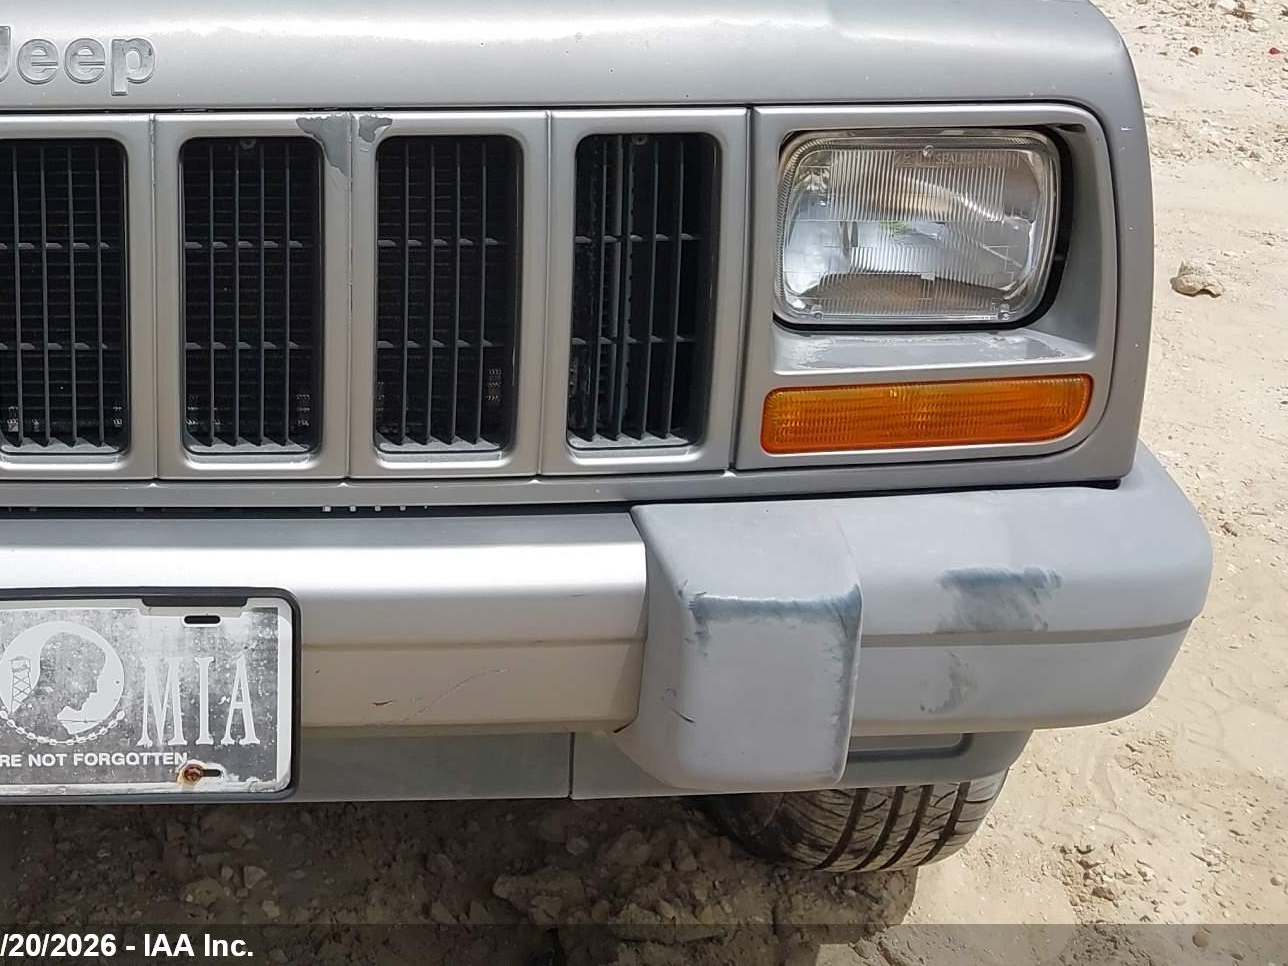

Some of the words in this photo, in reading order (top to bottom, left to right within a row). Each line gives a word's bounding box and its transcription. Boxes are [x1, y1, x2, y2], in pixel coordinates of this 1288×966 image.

[137, 655, 260, 746] MIA
[28, 753, 68, 767] NOT
[73, 752, 188, 766] FORGOTTEN
